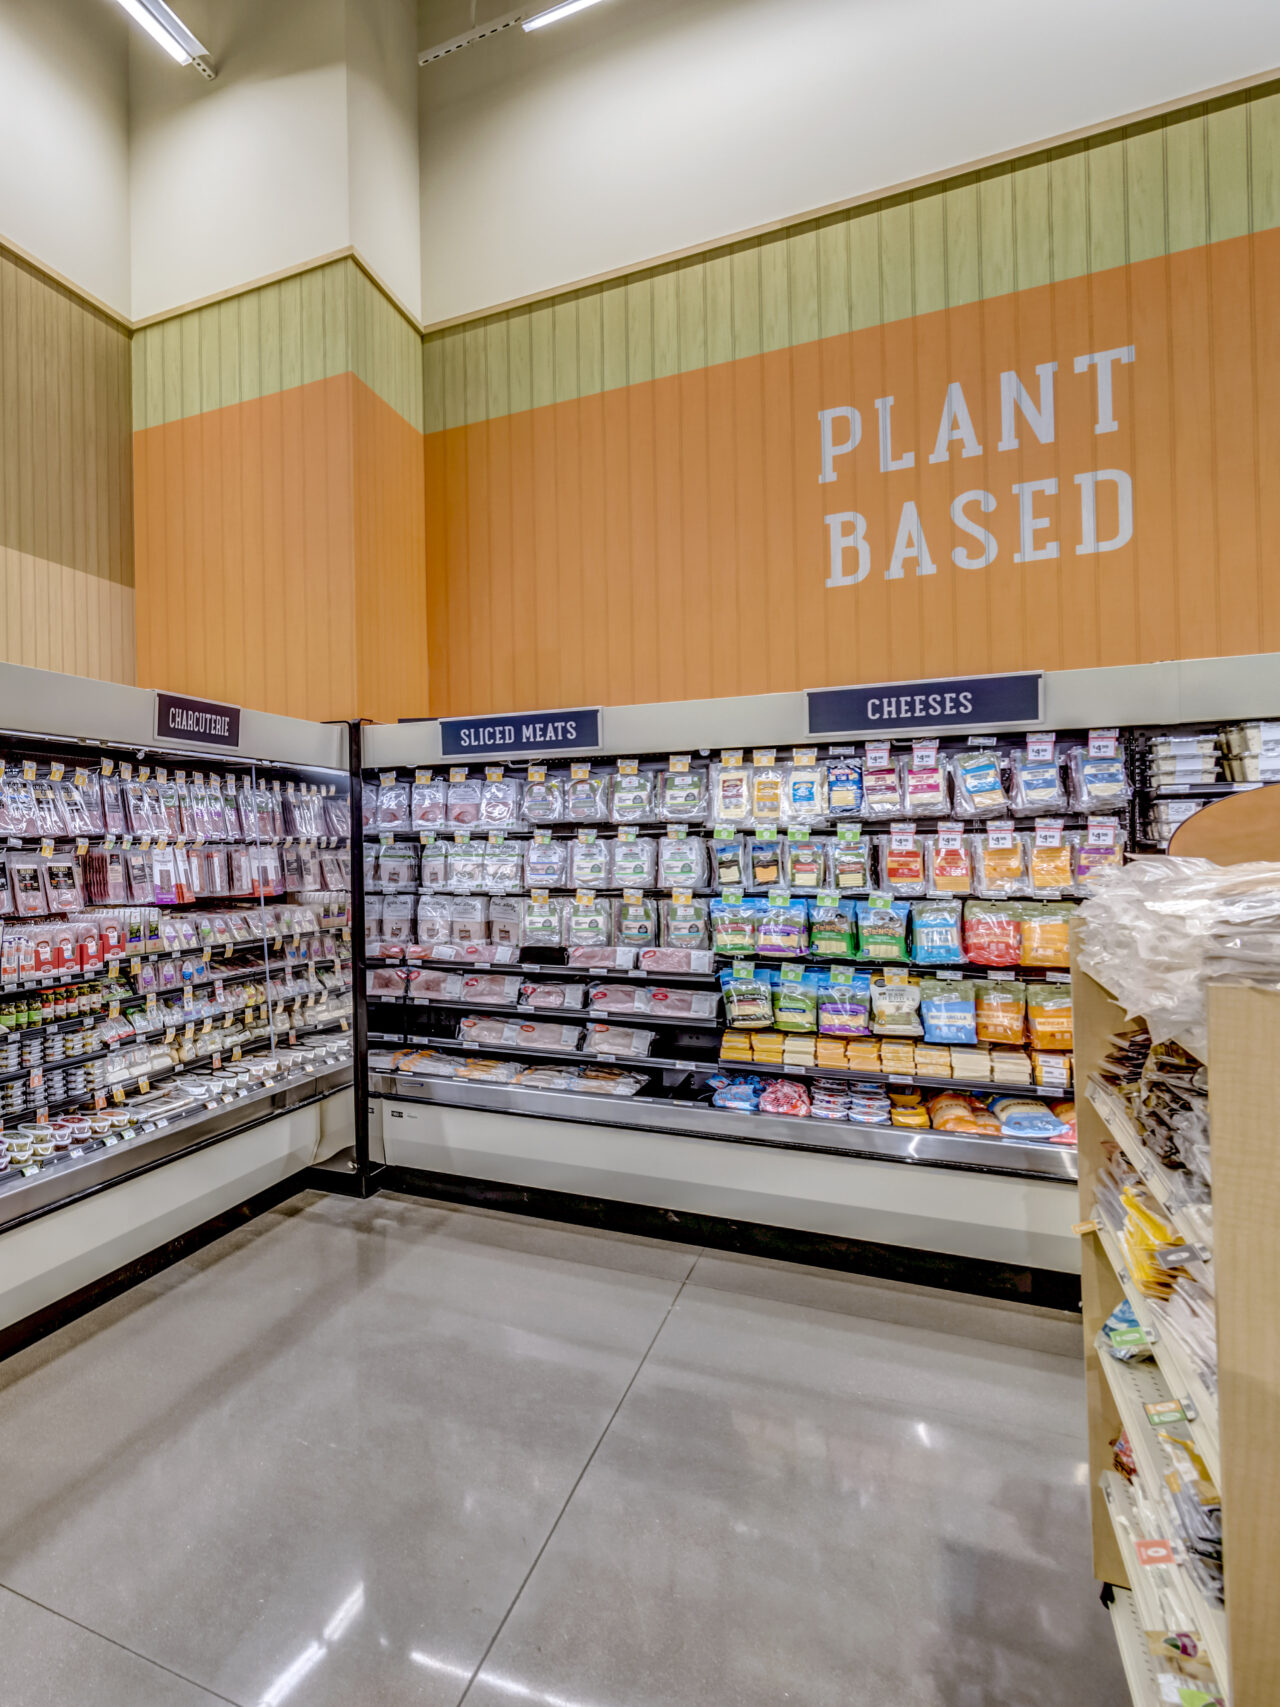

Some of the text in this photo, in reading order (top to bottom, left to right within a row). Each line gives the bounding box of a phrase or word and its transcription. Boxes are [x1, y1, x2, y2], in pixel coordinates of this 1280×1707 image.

[818, 344, 1135, 484] PLANT
[824, 468, 1134, 588] BASED
[867, 692, 973, 720] CHEESES
[169, 707, 230, 736] CHARCUTERIE
[460, 721, 577, 746] SLICED MEATS
